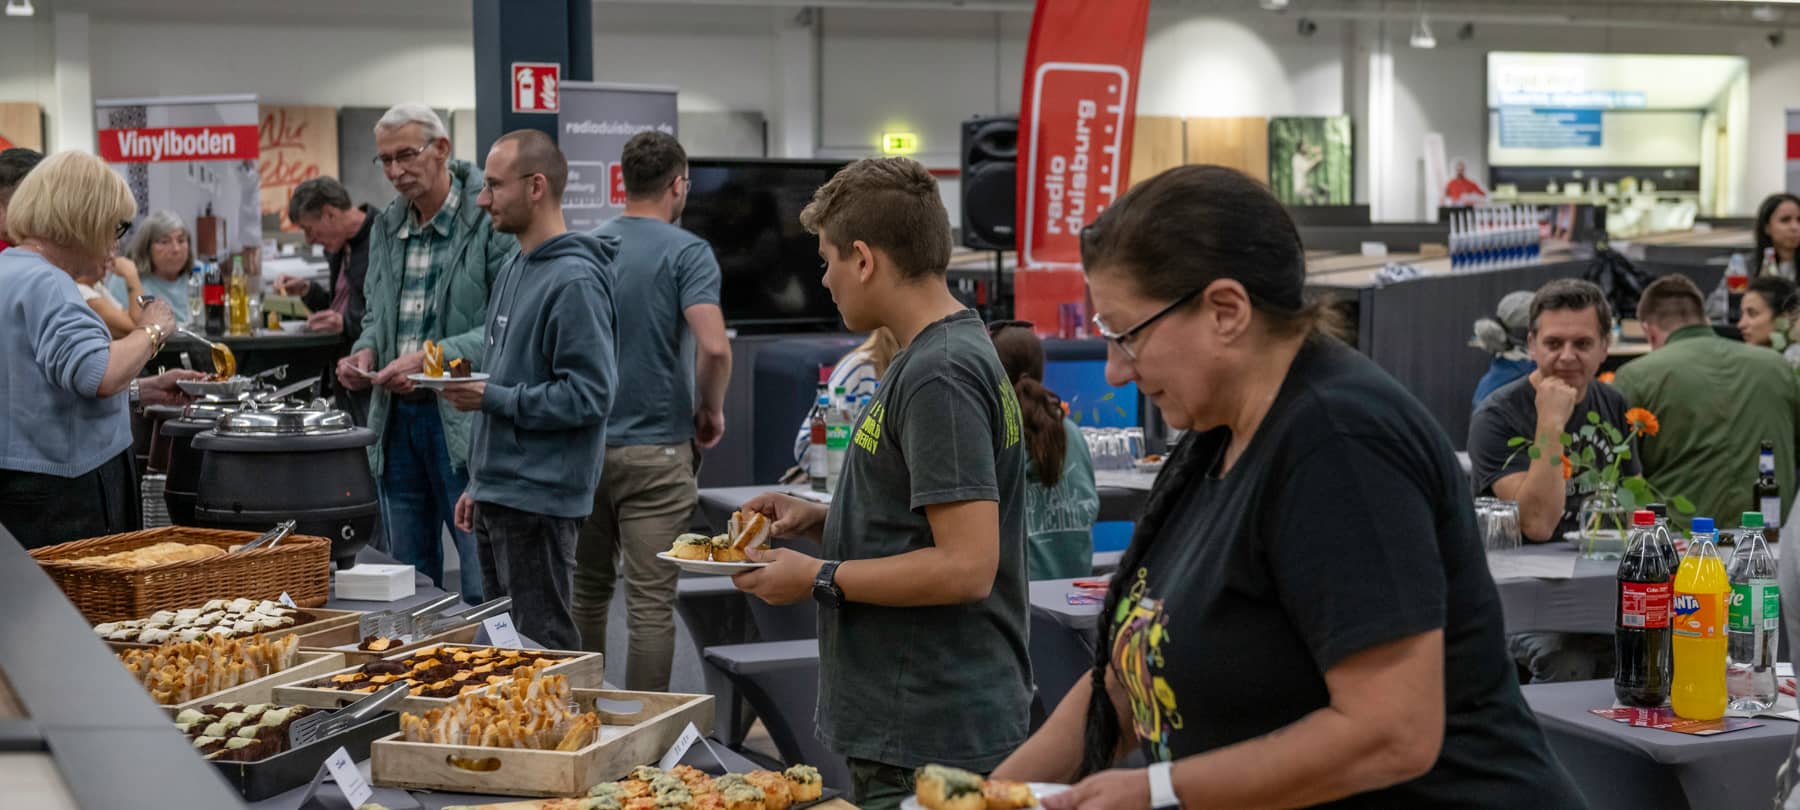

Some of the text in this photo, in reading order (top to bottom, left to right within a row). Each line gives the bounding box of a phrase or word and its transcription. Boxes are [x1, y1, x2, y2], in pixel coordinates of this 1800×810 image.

[117, 128, 236, 161] Vinylboden
[258, 150, 320, 182] eben
[1065, 99, 1097, 235] duisburg
[1045, 155, 1066, 234] radio
[1673, 594, 1700, 611] ANTA
